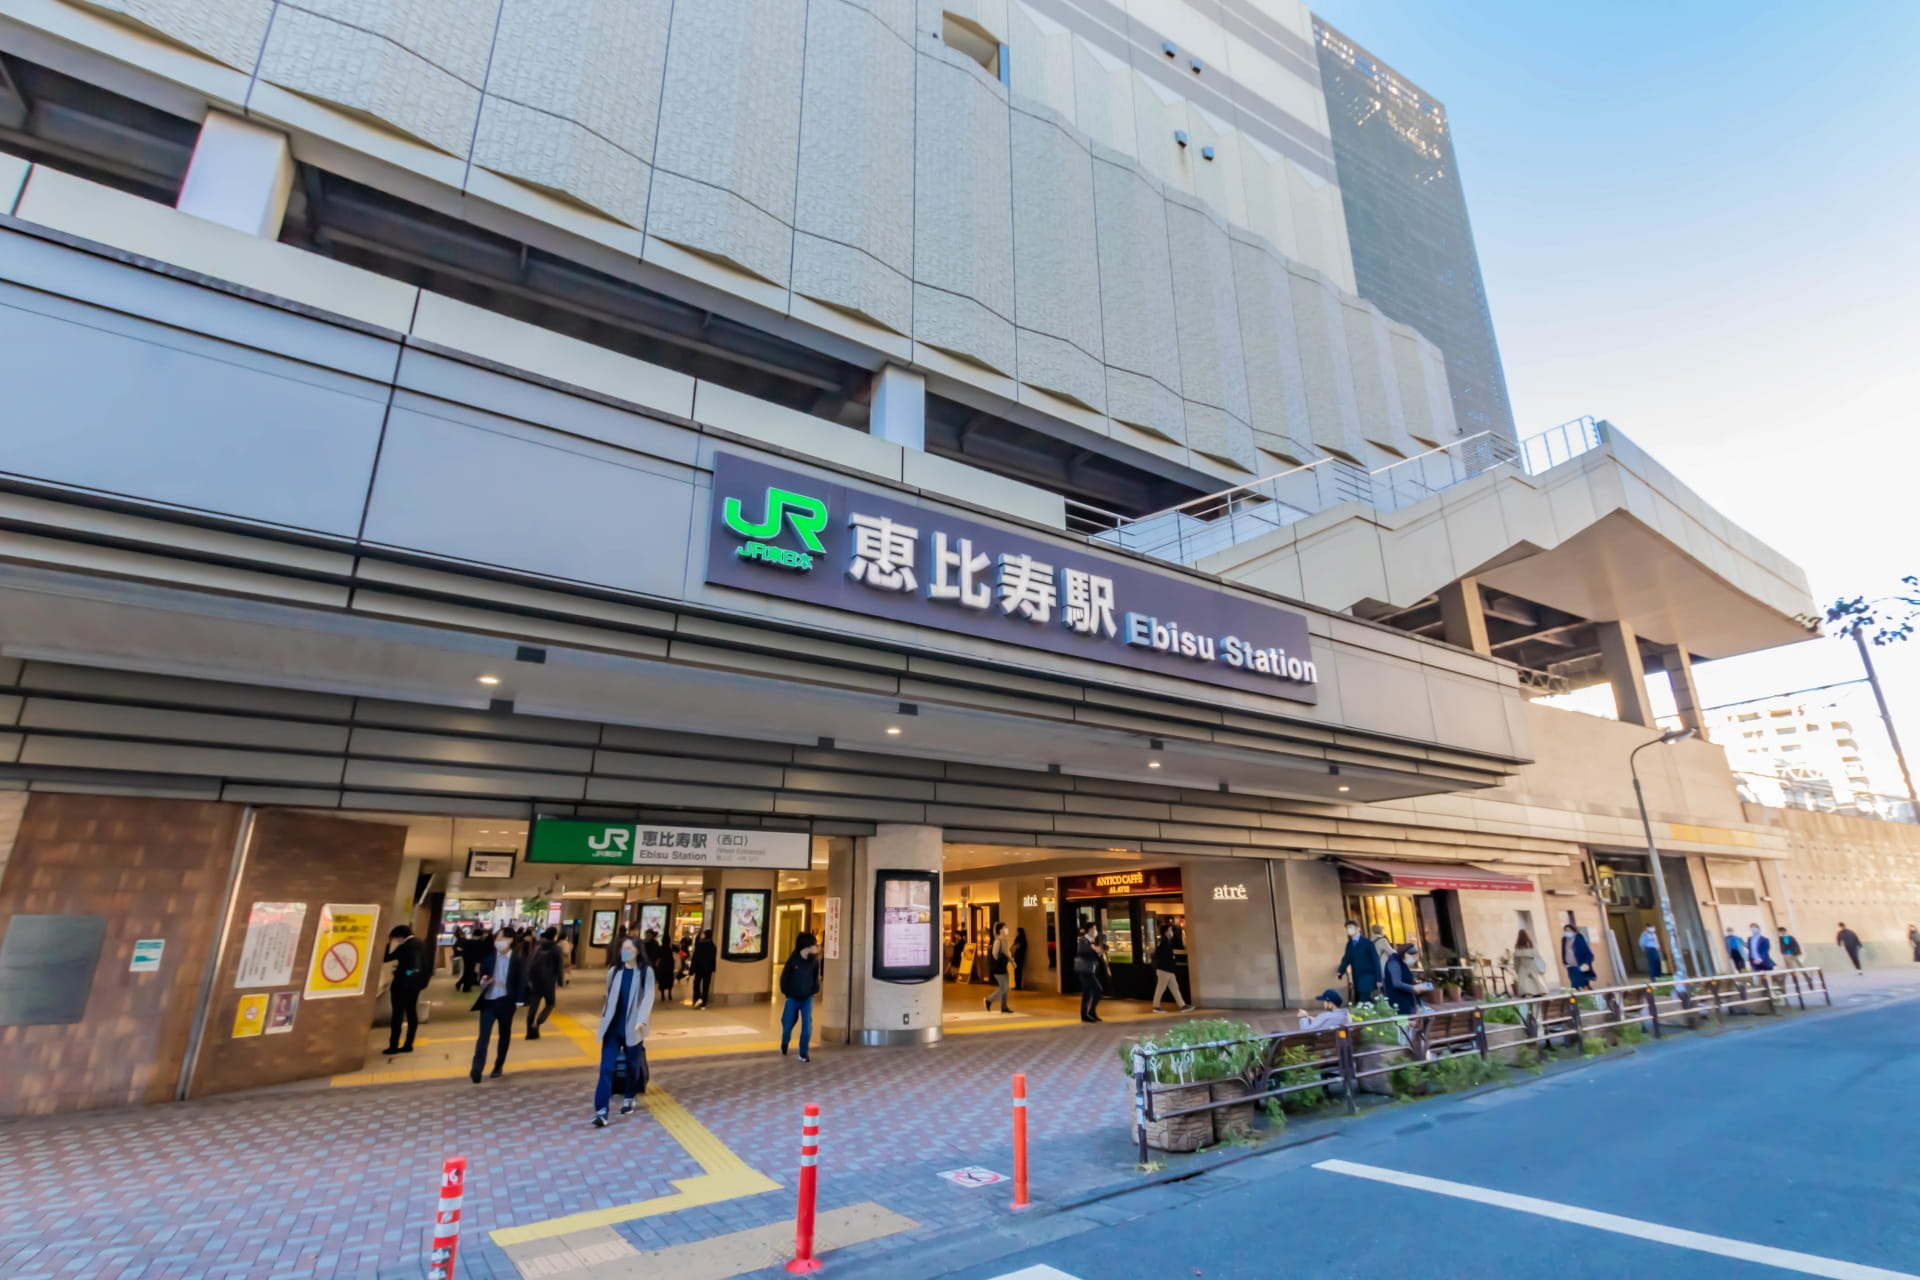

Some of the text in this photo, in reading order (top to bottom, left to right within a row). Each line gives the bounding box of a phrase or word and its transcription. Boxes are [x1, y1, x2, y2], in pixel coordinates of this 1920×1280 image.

[723, 486, 828, 554] JR
[847, 511, 1118, 638] 恵比寿駅
[1125, 612, 1318, 684] Ebisu Station
[588, 828, 630, 851] JR
[641, 830, 708, 849] 恵比寿駅
[640, 849, 669, 860] Ebisu
[672, 850, 707, 861] Station
[1213, 883, 1249, 899] atré
